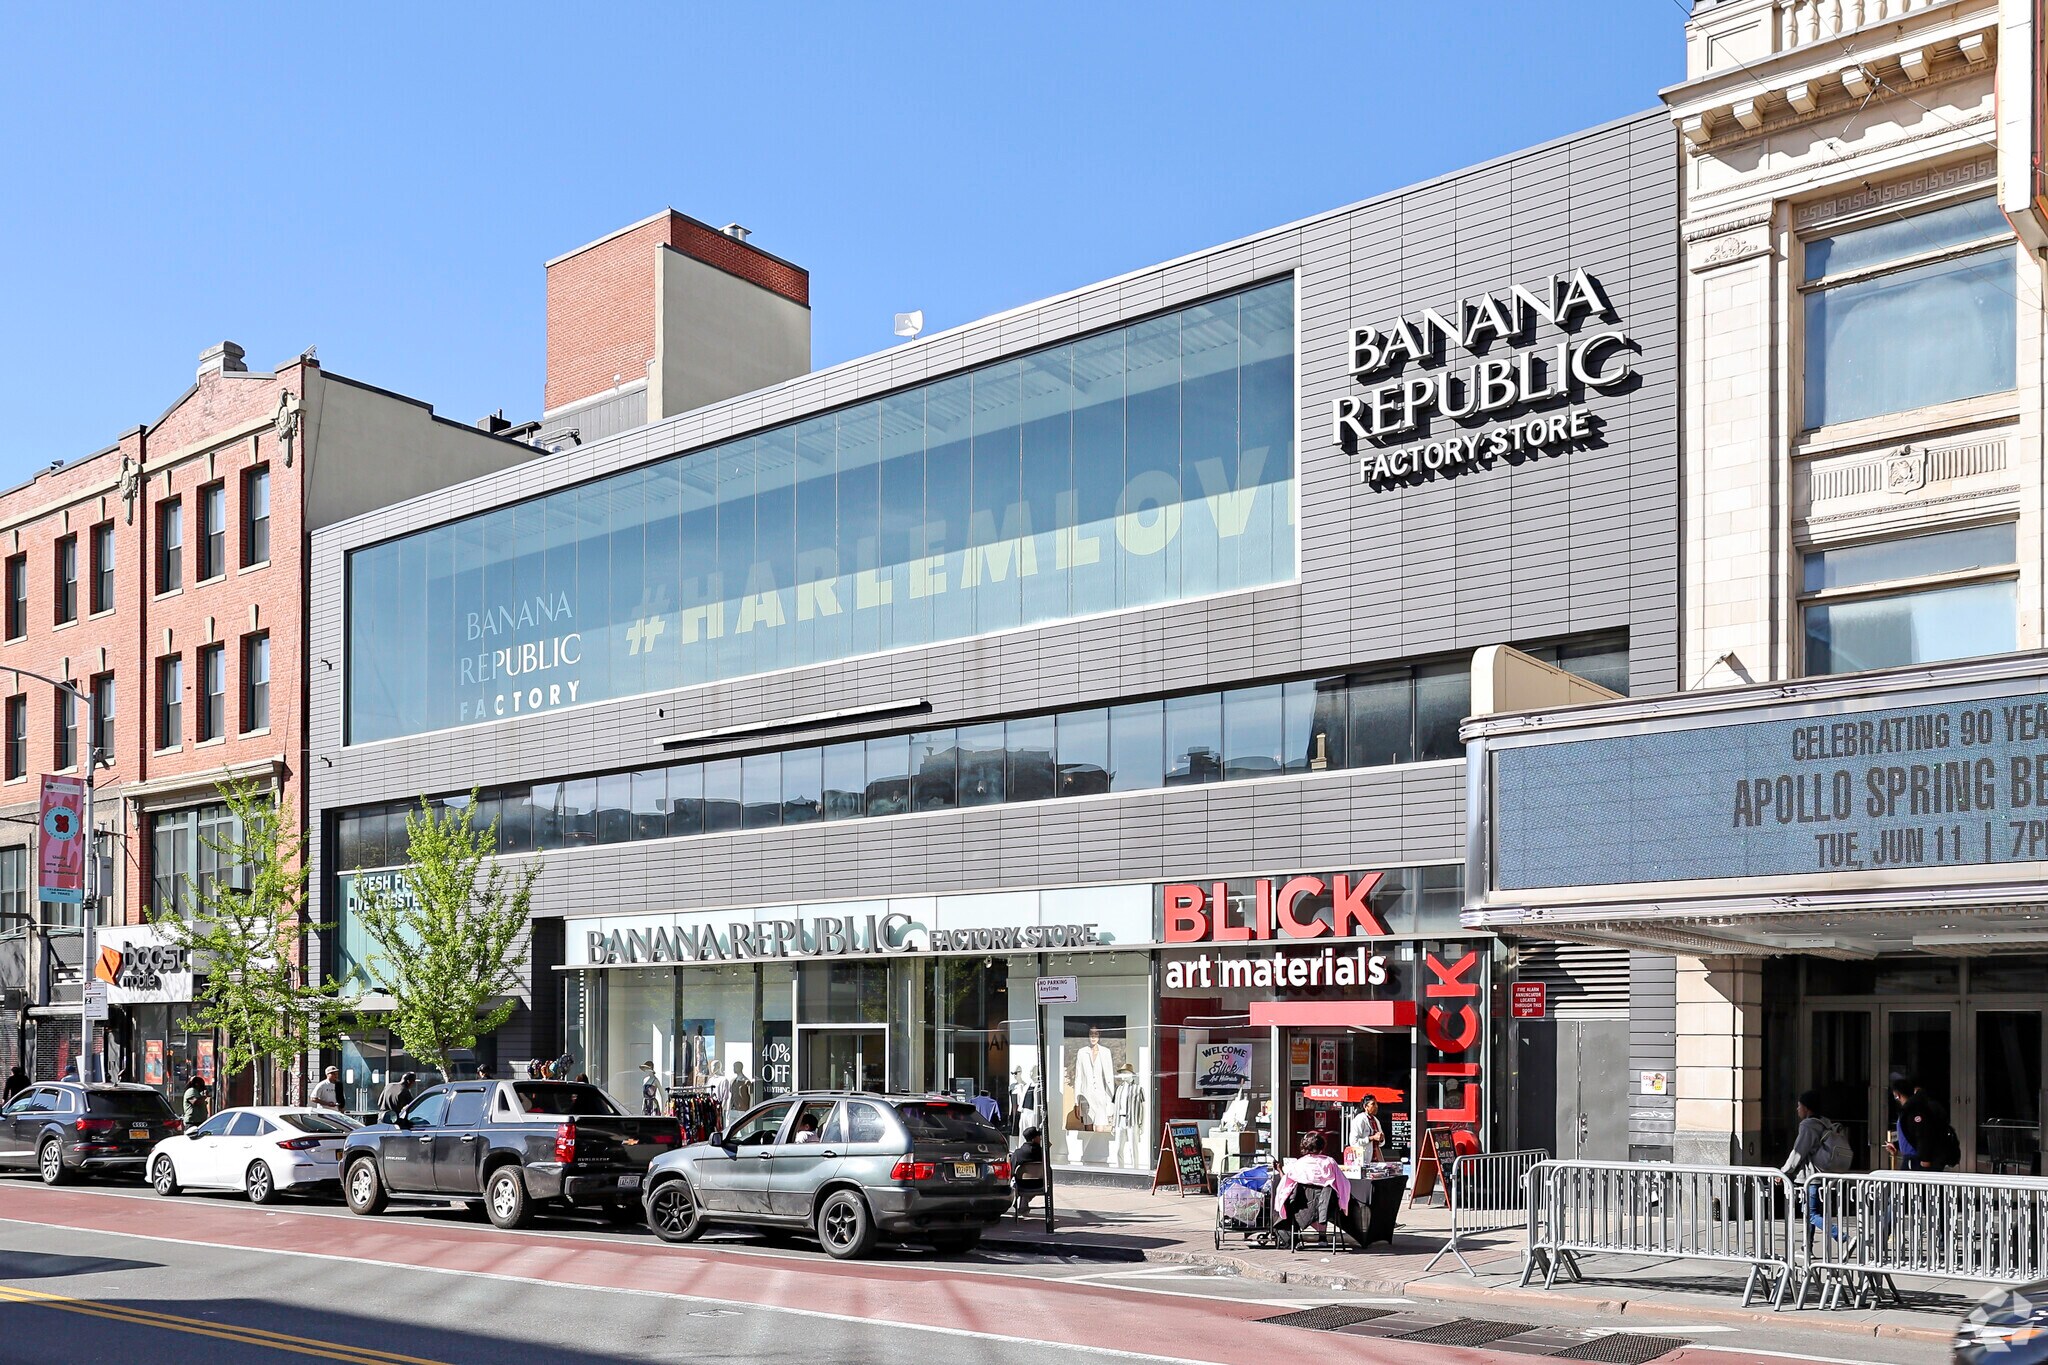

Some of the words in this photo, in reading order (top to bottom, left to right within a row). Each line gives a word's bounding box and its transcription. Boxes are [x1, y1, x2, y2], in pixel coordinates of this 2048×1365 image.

[1347, 267, 1607, 377] BANANA
[1332, 331, 1629, 446] REPUBLIC
[466, 590, 573, 642] BANANA
[460, 633, 581, 686] REPUBLIC
[460, 680, 580, 722] FACTORY
[1792, 713, 1950, 761] CELEBRATING
[1960, 708, 1993, 746] 90
[1733, 769, 1851, 828] APOLLO
[1866, 757, 1995, 818] SPRING
[1815, 831, 1863, 870] TUE,
[1873, 827, 1924, 865] JUN
[1934, 825, 1961, 862] 11
[2009, 819, 2048, 858] 7P
[1164, 872, 1385, 943] BLICK
[123, 938, 185, 972] boost
[587, 923, 726, 965] BANANA
[728, 912, 914, 963] REPUBLIC
[929, 926, 1021, 952] FACTORY
[1024, 923, 1099, 949] STORE
[123, 973, 157, 988] mobile
[1166, 954, 1212, 989] art
[1222, 946, 1387, 987] materials
[762, 1043, 790, 1062] 40%
[762, 1064, 790, 1083] OFF
[1202, 1046, 1248, 1058] WELCOME
[1310, 1088, 1339, 1097] BLICK
